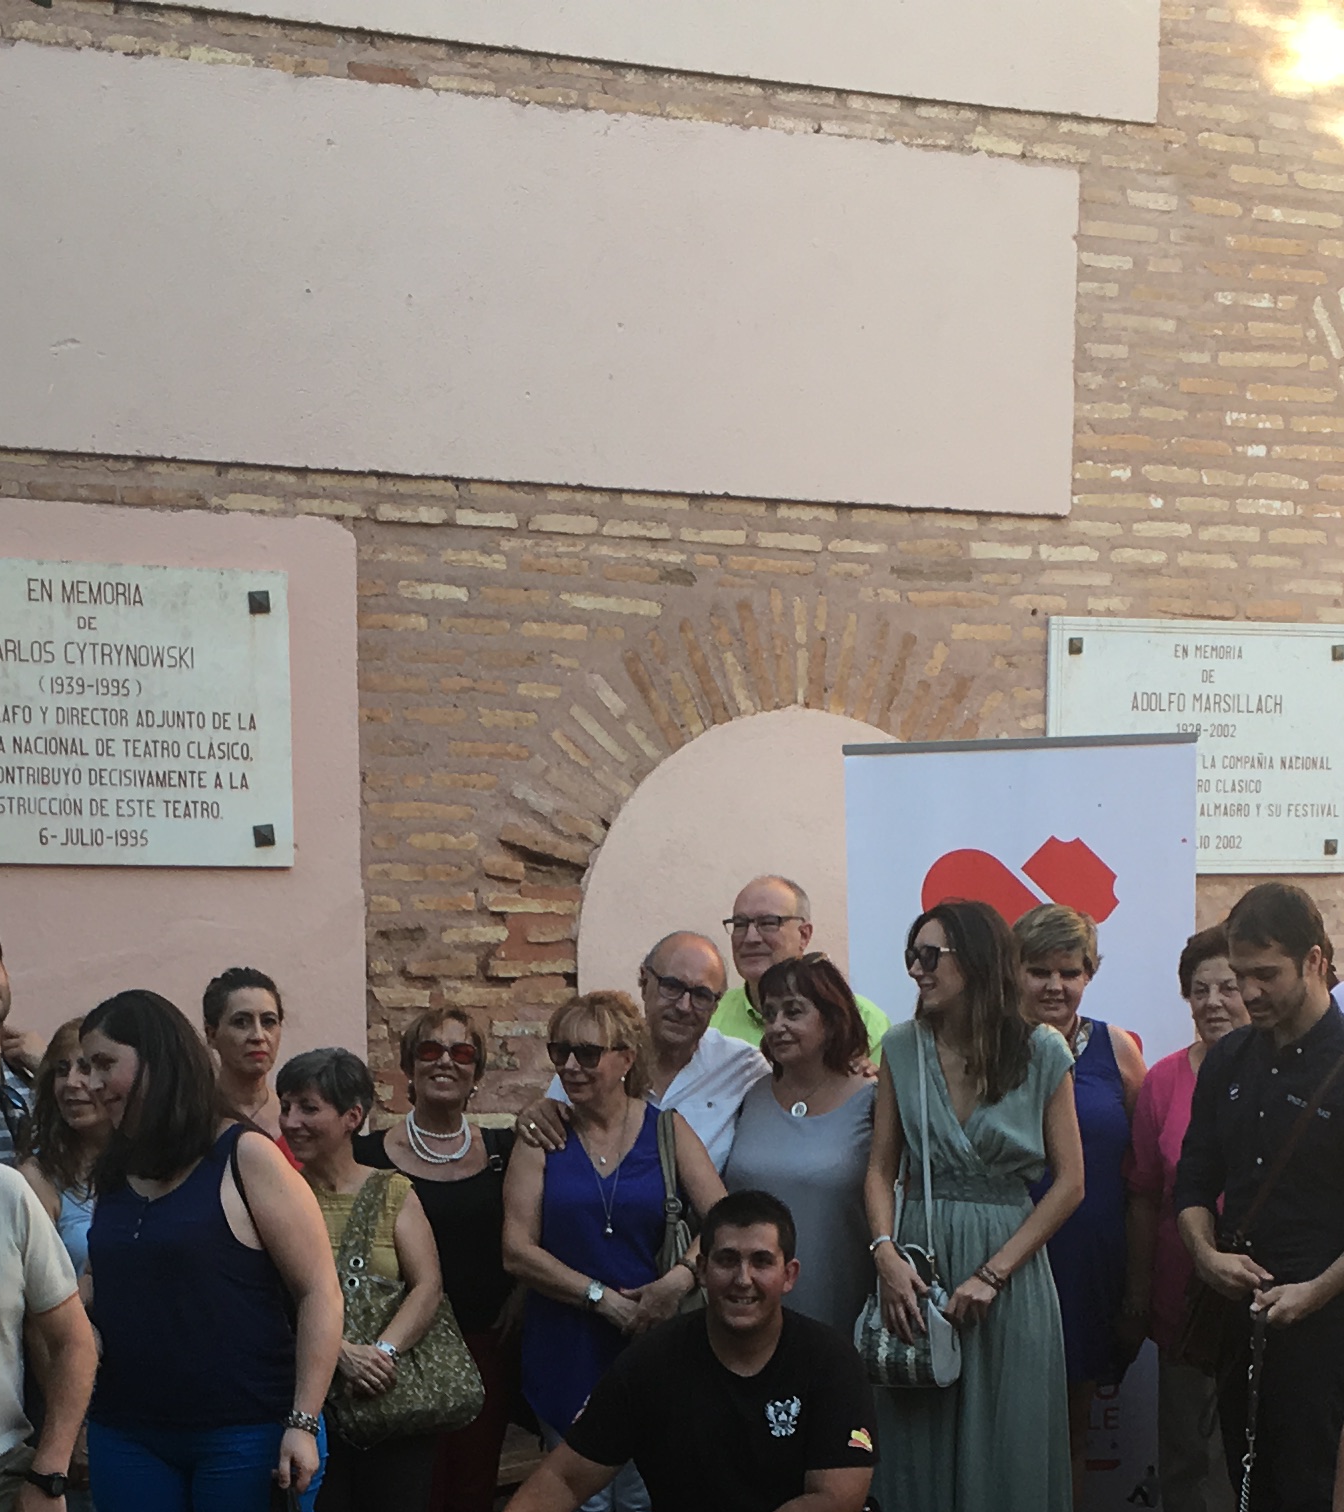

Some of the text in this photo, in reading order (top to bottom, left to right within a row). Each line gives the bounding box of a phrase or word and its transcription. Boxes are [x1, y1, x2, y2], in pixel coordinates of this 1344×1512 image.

[27, 578, 144, 606] EN MEMORIA
[77, 616, 97, 630] DE
[64, 641, 195, 669] CYTRYNOWSKI
[1174, 643, 1243, 660] EN MEMORIA
[1201, 669, 1215, 684] DE
[1131, 691, 1283, 714] ADOLFO MARSILLACH
[39, 706, 49, 725] Y
[56, 706, 129, 727] DIRECTOR
[136, 709, 206, 729] ADJUNTO
[212, 712, 231, 730] DE
[238, 713, 257, 731] LA
[13, 736, 89, 756] NACIONAL
[96, 738, 115, 757] DE
[123, 739, 181, 758] TEATRO
[1202, 752, 1332, 770] LA COMPAÑIA NACIONAL
[89, 768, 207, 789] DECISIVAMENTE
[214, 772, 223, 789] A
[229, 772, 249, 790] LA
[1216, 779, 1262, 794] CLASICO
[89, 799, 109, 817] DE
[116, 799, 156, 818] ESTE
[163, 800, 223, 820] TEATRO.
[1199, 803, 1340, 818] ALMAGRO Y SU FESTIVAL
[1215, 835, 1243, 850] 2002
